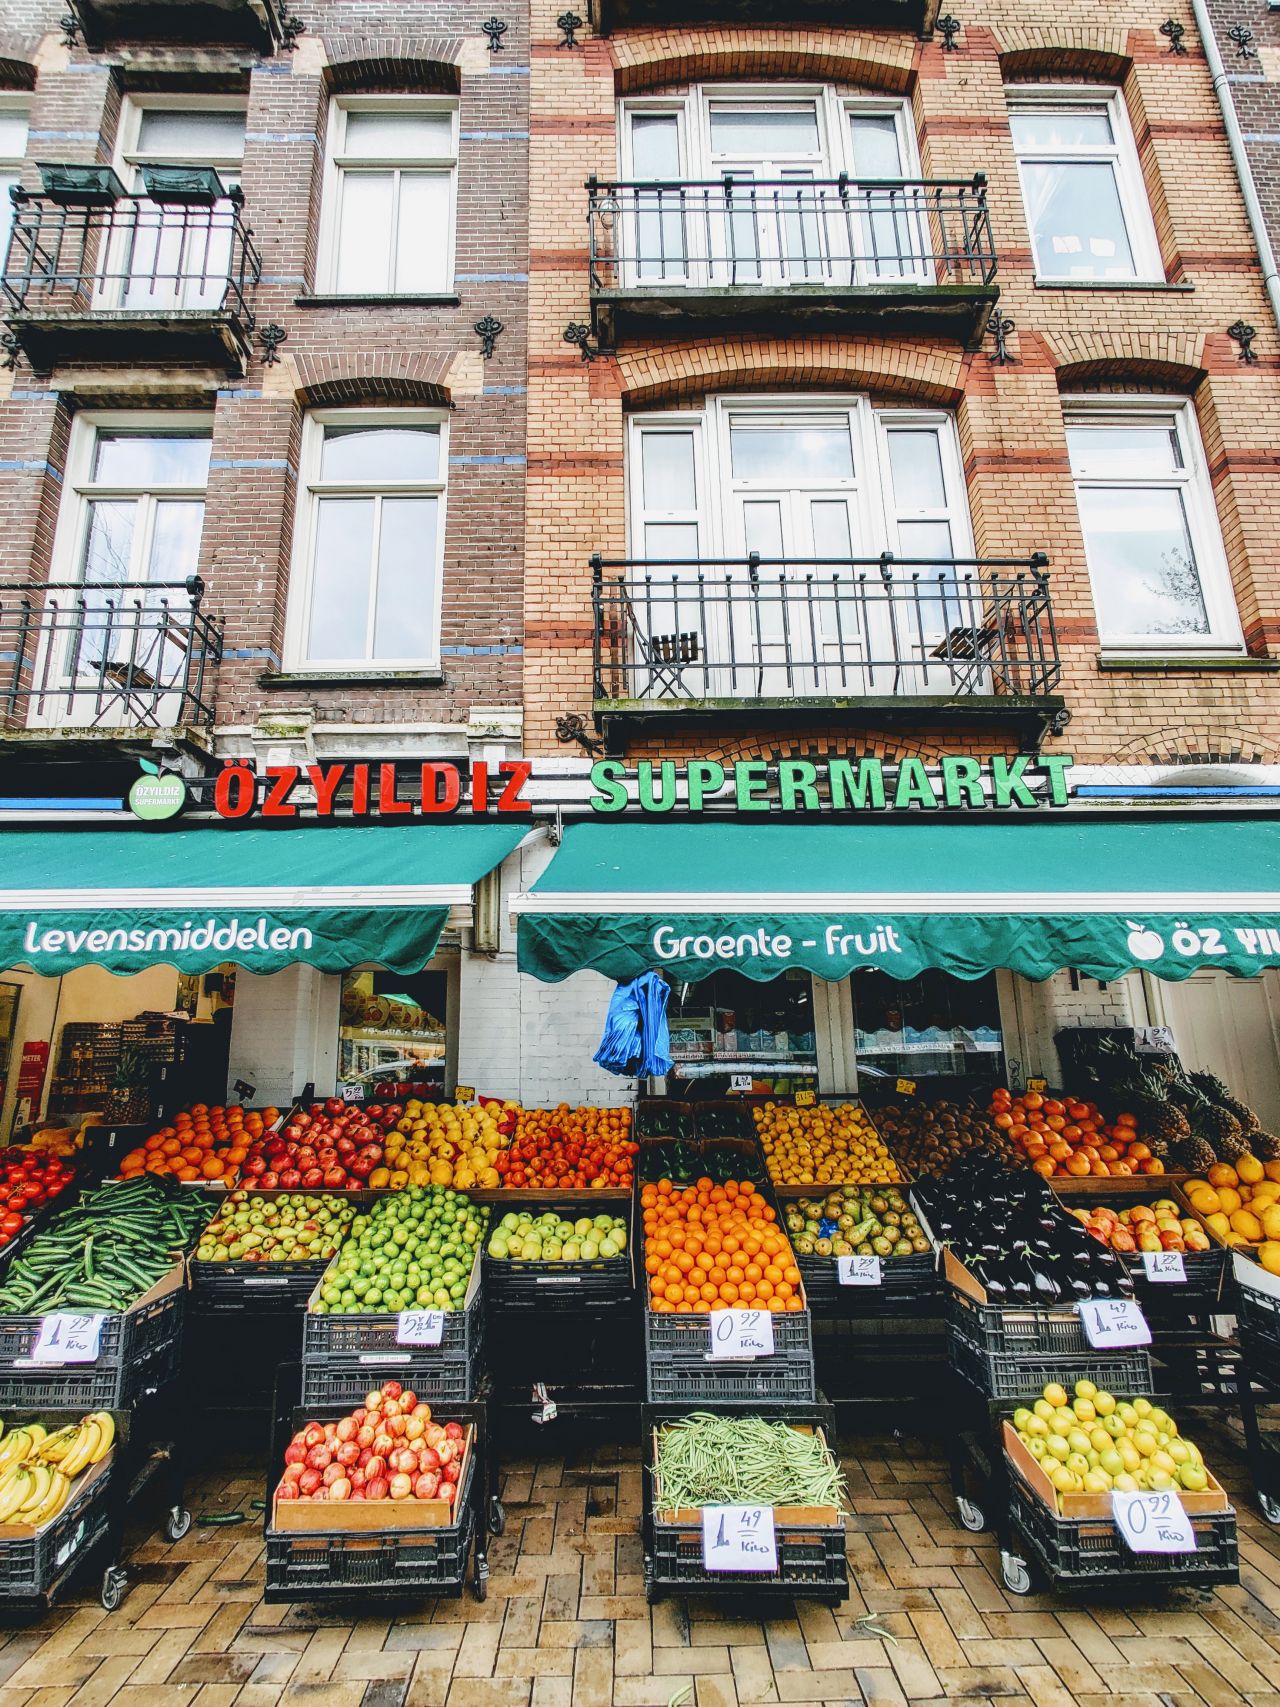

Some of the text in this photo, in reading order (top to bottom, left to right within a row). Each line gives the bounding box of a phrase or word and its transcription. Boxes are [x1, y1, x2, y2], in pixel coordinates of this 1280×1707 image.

[214, 755, 1073, 818] ÖZYILDIZ SUPERMARKT
[23, 918, 313, 953] Levensmiddelen
[653, 926, 792, 959] Groente
[1172, 921, 1228, 956] ÖZ
[741, 1540, 770, 1554] Kilo
